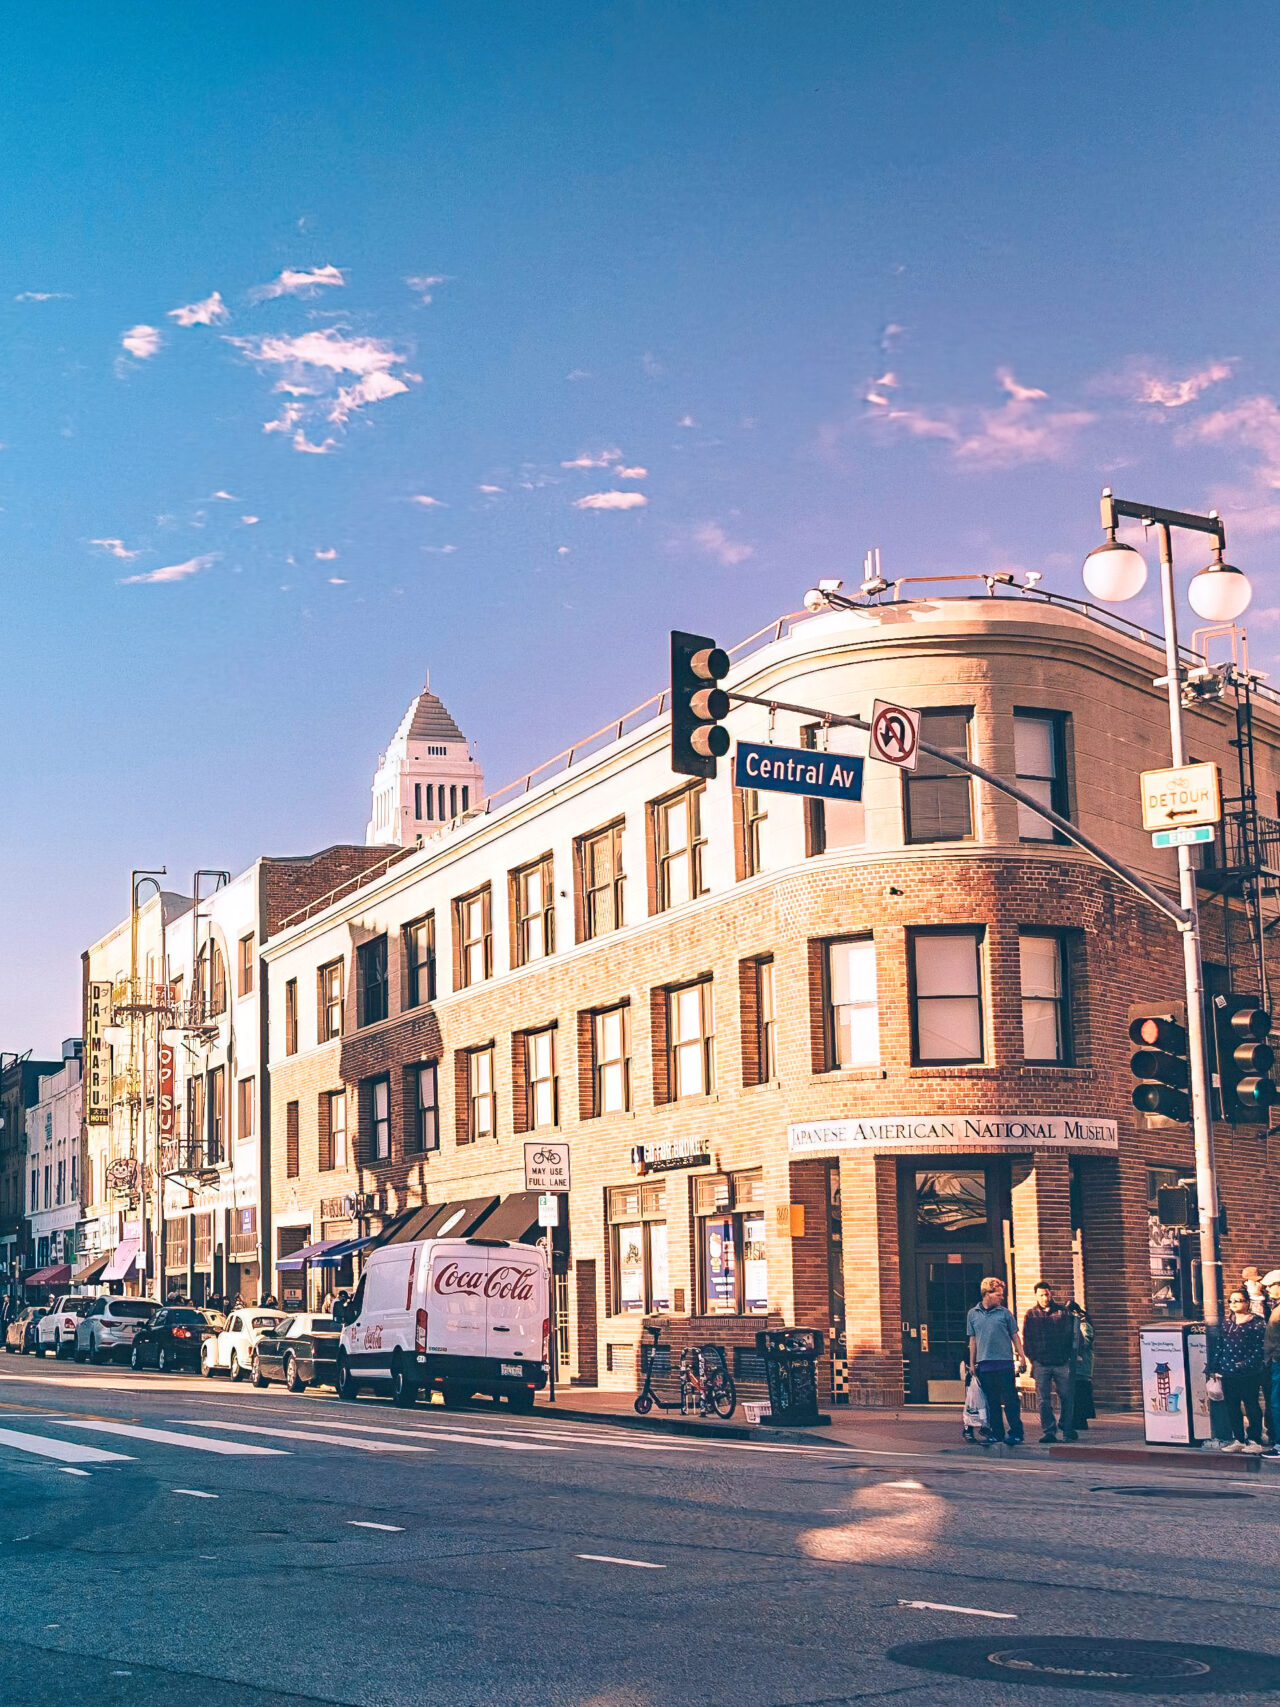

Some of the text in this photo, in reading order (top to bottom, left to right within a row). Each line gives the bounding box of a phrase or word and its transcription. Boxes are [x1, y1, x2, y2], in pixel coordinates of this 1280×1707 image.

[746, 753, 854, 788] Central Av
[1149, 791, 1209, 808] DETOUR
[92, 986, 101, 1105] DAIMARU
[792, 1119, 1116, 1146] JAPANESE AMERICAN NATIONAL MUSEUM
[529, 1178, 567, 1187] FULL LANE
[532, 1168, 563, 1176] MAY USE
